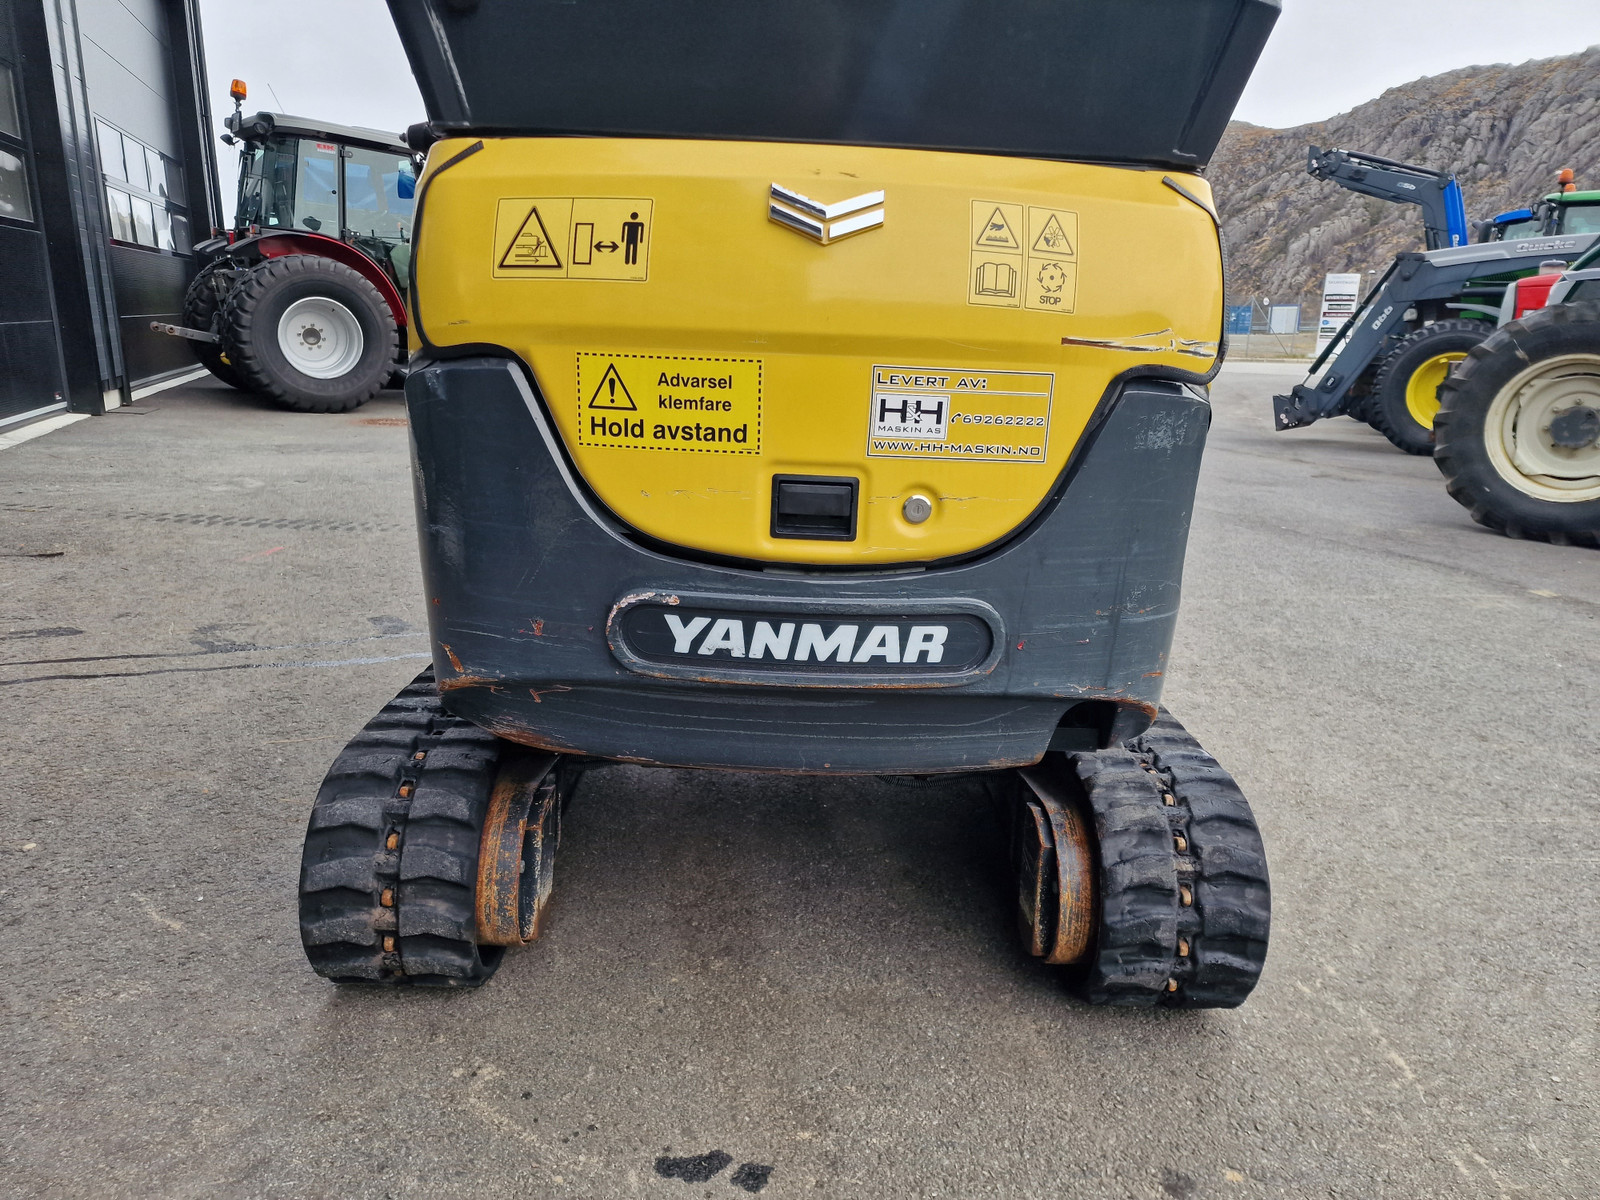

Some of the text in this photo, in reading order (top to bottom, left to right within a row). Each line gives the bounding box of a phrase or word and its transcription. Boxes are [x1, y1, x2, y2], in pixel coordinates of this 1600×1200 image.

[1515, 240, 1576, 253] Quicke
[1039, 295, 1061, 306] STOP
[657, 372, 733, 389] Advarsel
[877, 372, 988, 389] LEVERT AV:
[658, 394, 732, 412] klemfare
[879, 398, 943, 425] H&H
[962, 414, 1045, 426] 69262222
[590, 416, 748, 444] Hold avstand
[877, 425, 922, 433] MASKIN
[874, 441, 1041, 456] WWW.HH-MASKIN.NO
[664, 614, 949, 663] YANMAR
